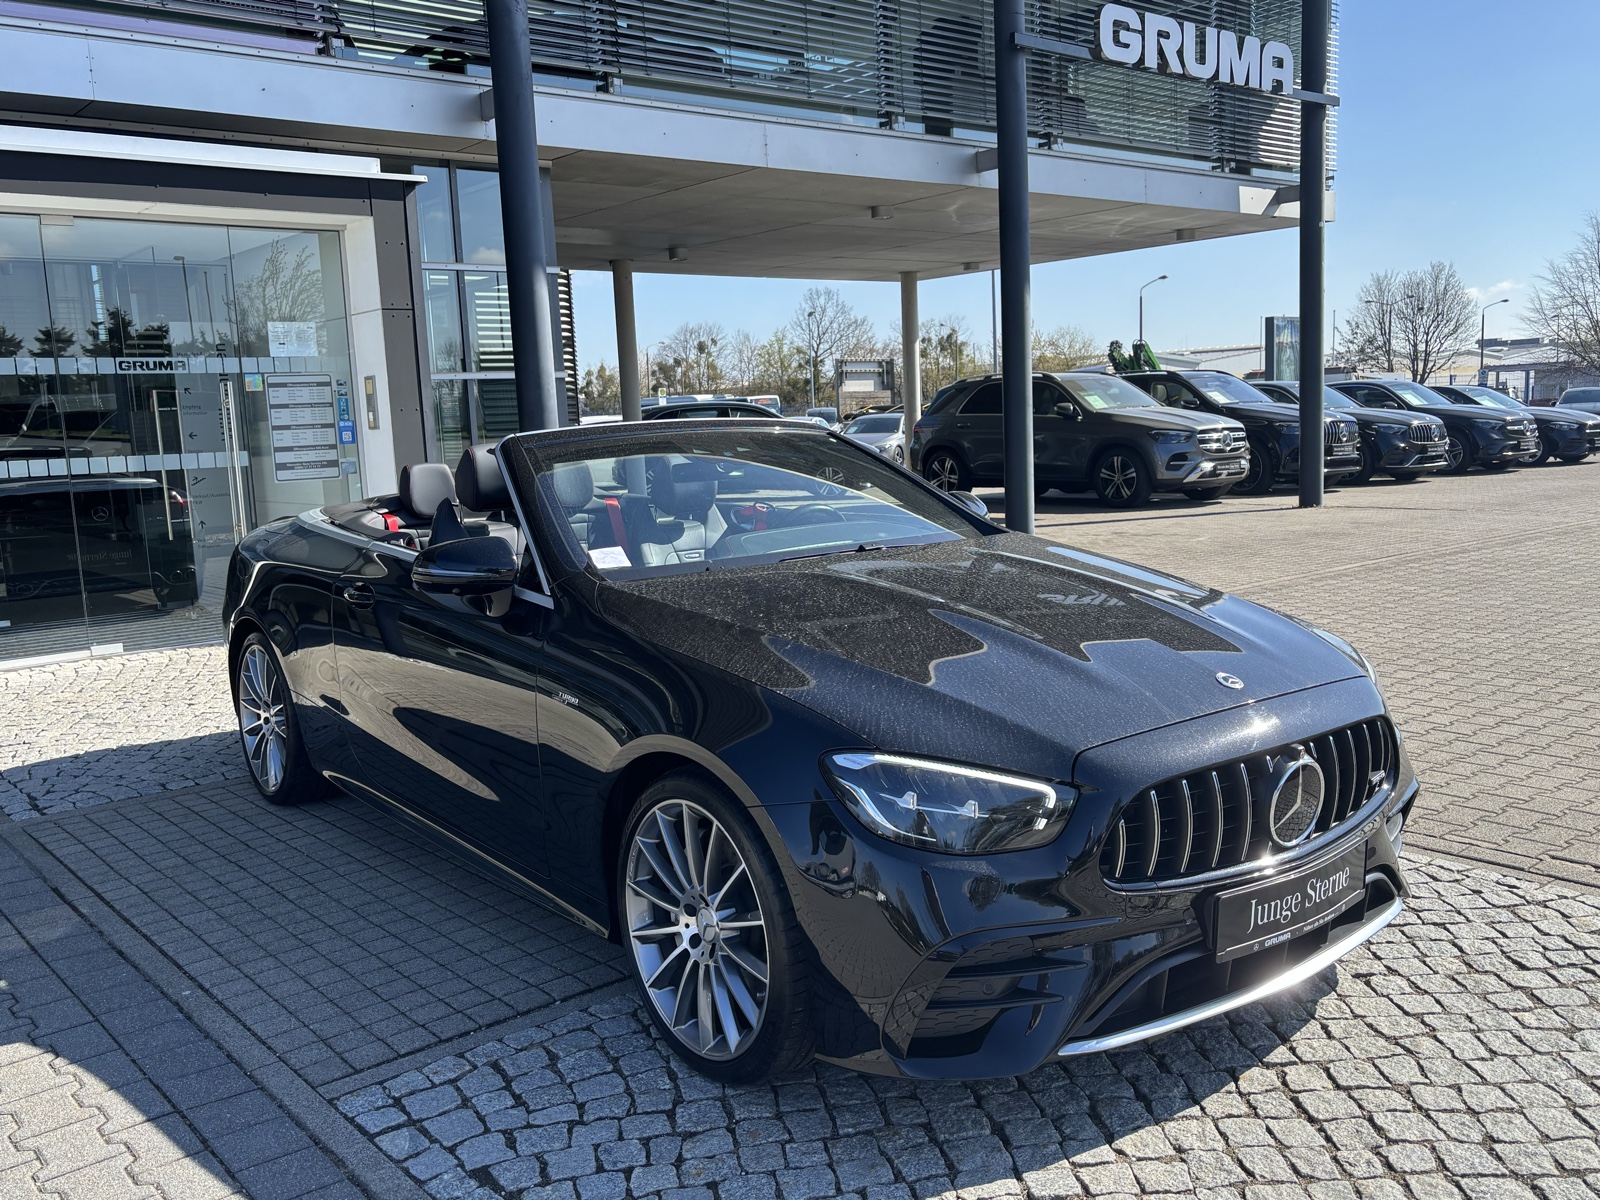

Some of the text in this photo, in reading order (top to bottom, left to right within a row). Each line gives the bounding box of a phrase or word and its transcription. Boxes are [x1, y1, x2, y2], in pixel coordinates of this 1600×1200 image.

[1098, 2, 1294, 95] GRUMA
[118, 360, 187, 372] GRUMA
[1246, 866, 1350, 934] Junge Sterne
[1264, 932, 1292, 947] GRUMA
